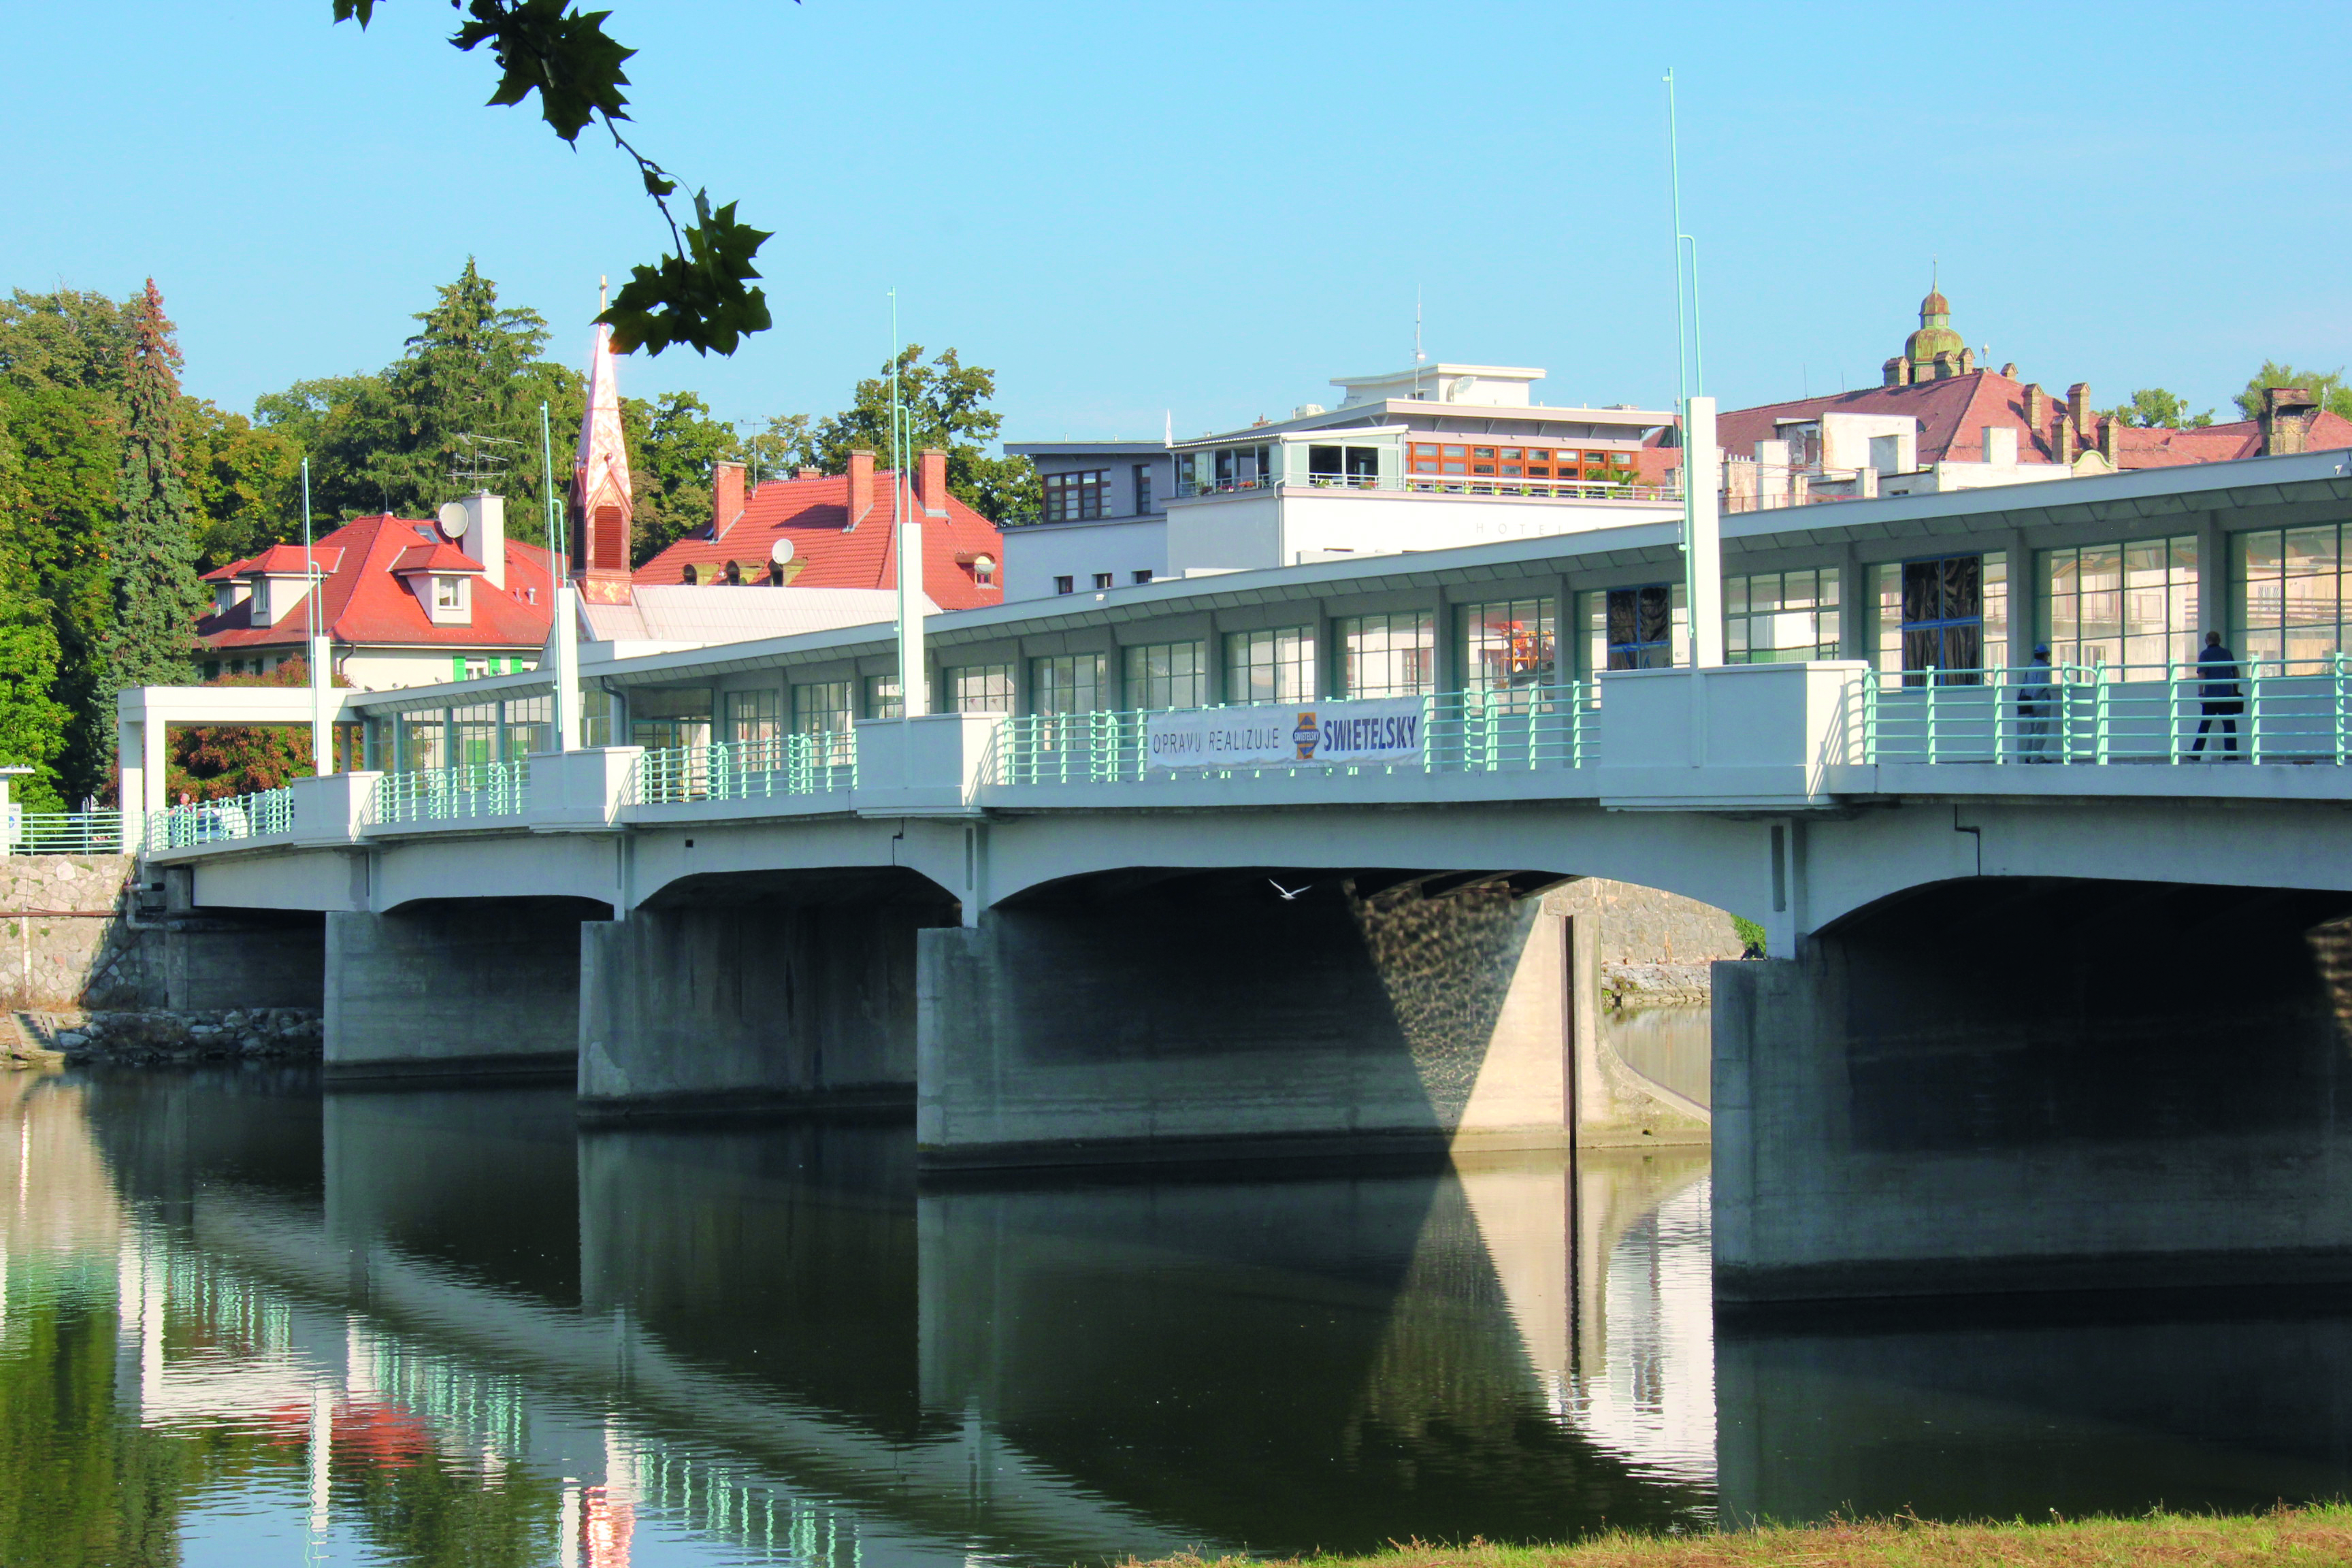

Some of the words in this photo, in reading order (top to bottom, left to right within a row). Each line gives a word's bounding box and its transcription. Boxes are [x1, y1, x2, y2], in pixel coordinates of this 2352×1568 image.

[1154, 733, 1201, 754] OPRAVU
[1209, 728, 1279, 751] REALIZUJE
[1294, 731, 1320, 741] SWIETELSKY
[1324, 716, 1417, 751] SWIETELSKY
